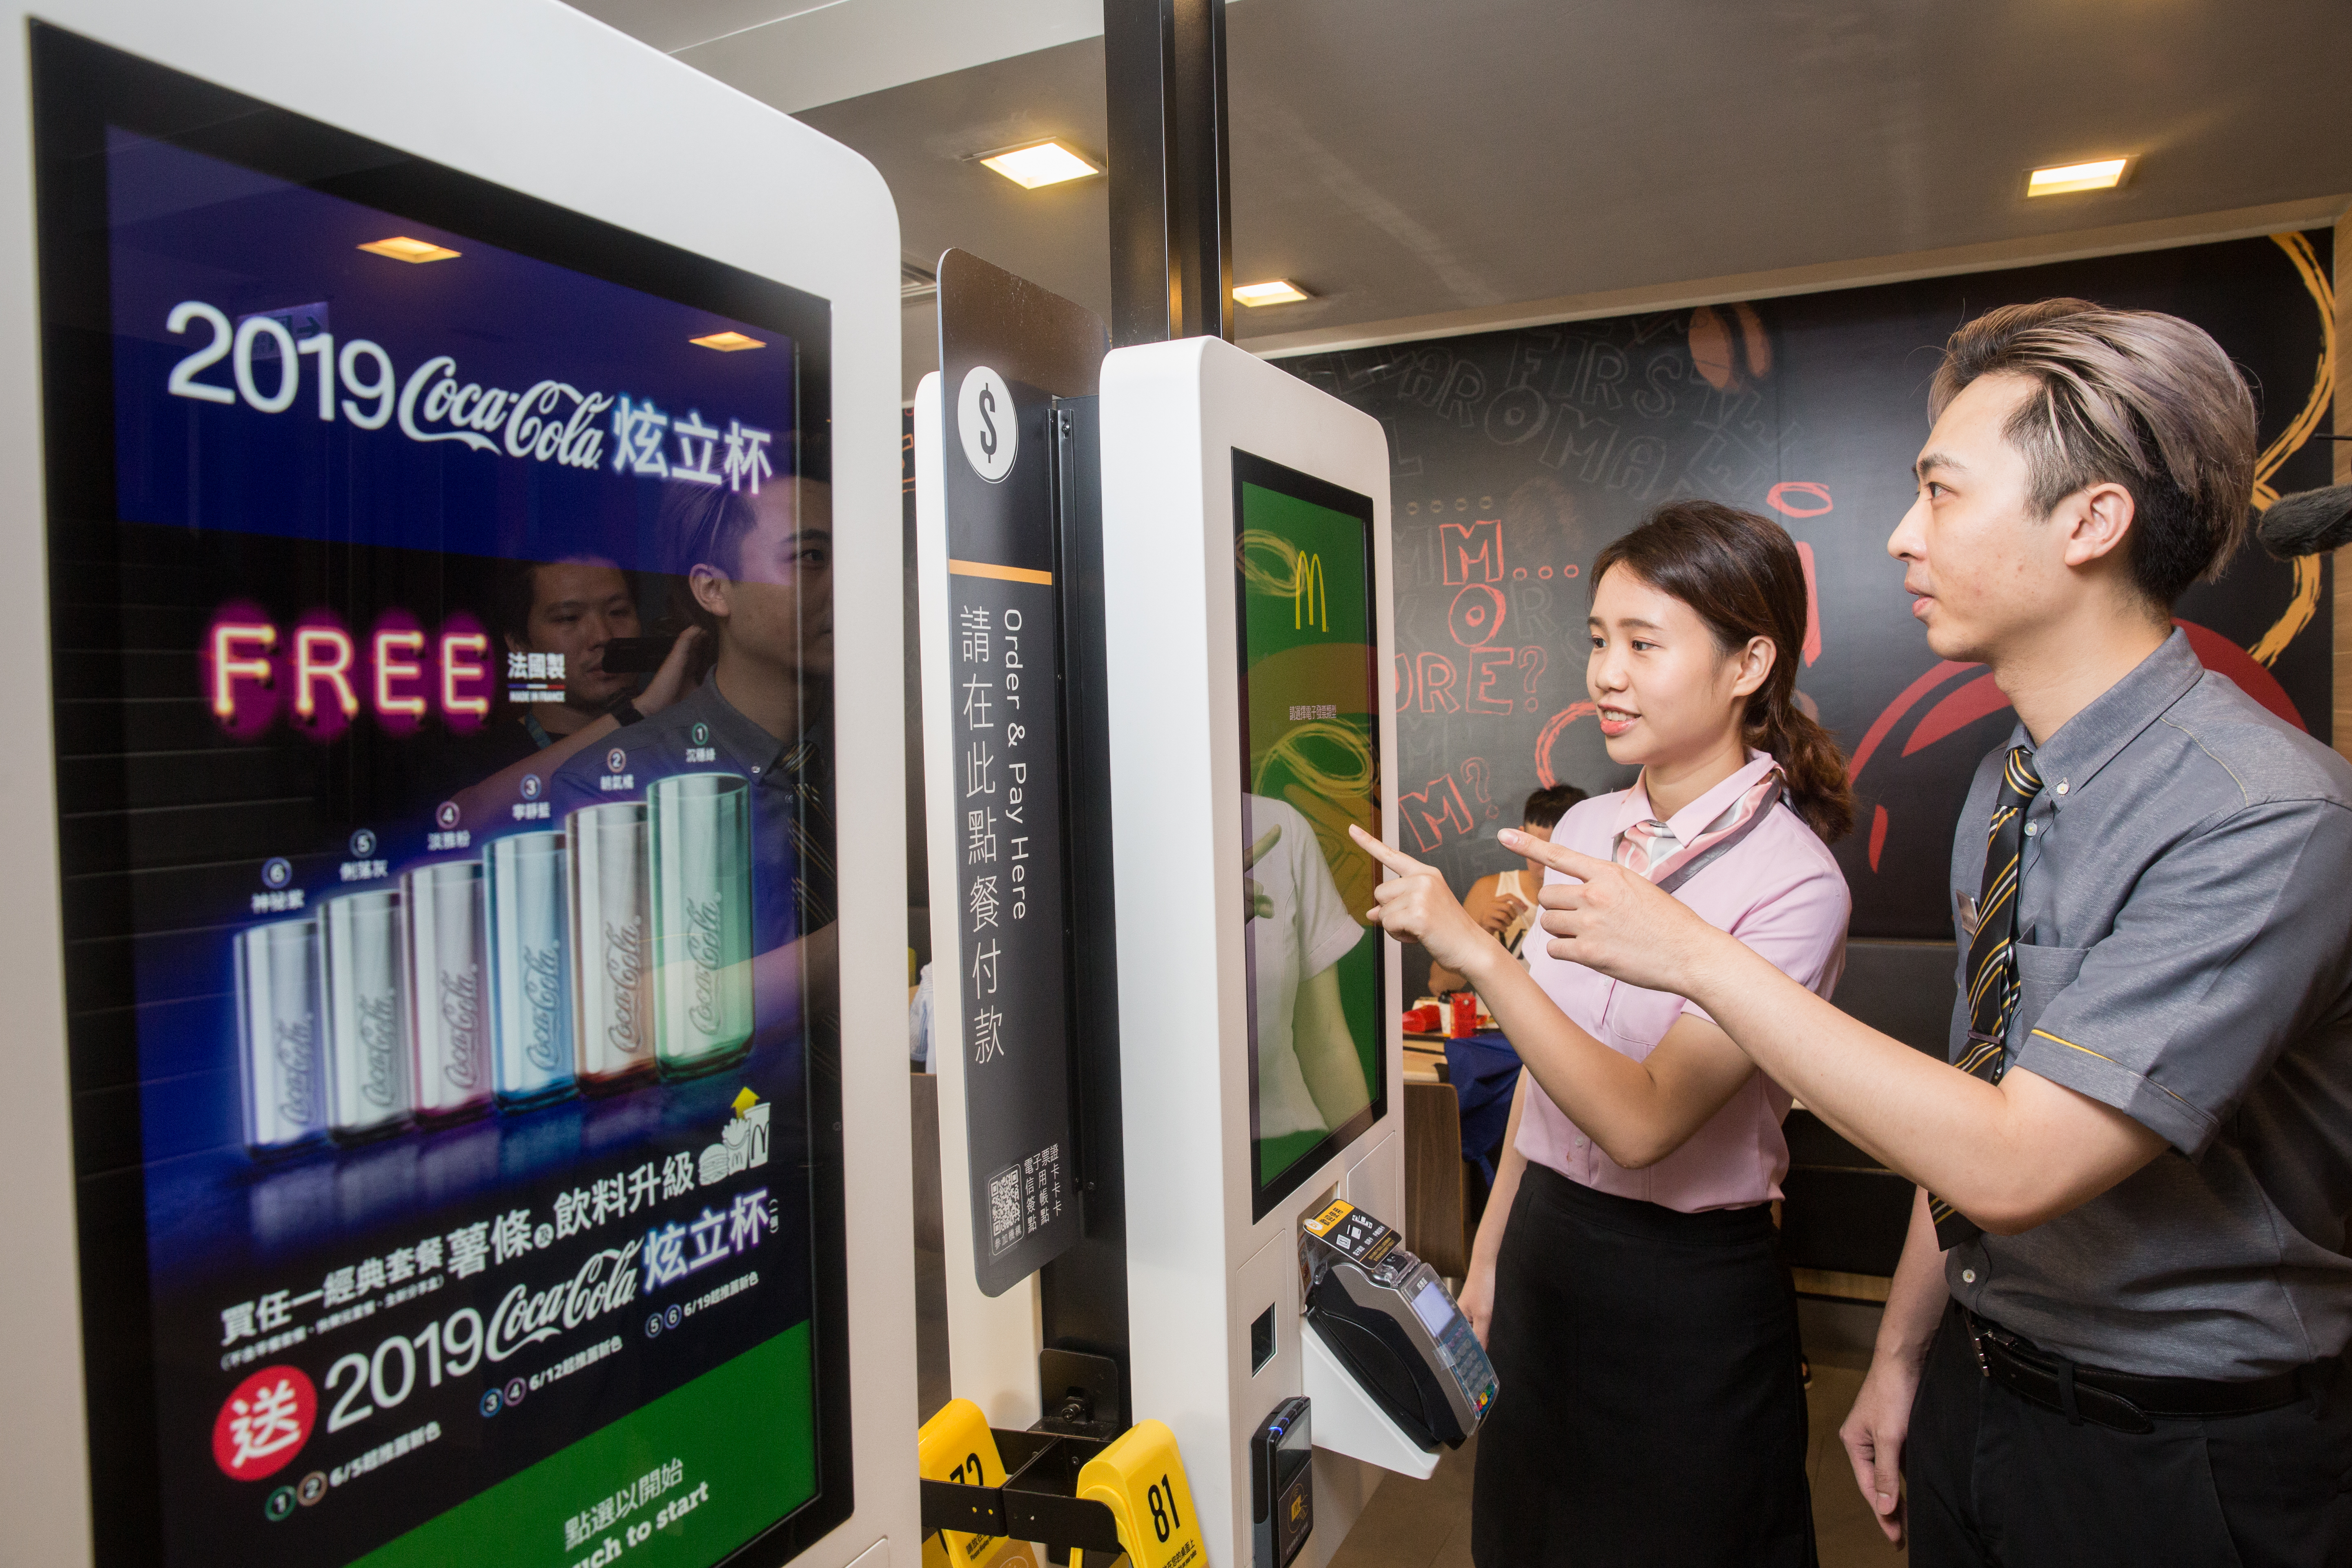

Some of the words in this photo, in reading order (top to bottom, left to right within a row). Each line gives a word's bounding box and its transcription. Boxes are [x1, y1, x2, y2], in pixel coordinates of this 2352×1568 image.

[166, 301, 394, 430] 2019
[398, 356, 614, 470] Coca-Cola
[614, 397, 773, 495] 炫立杯
[215, 623, 487, 715] FREE
[1004, 609, 1024, 705] Order
[1007, 723, 1025, 748] &
[1289, 705, 1336, 721] 請選擇電子發票類型
[1006, 762, 1027, 824] Pay
[960, 605, 1004, 1064] 請在此點餐付款
[1011, 837, 1029, 920] Here
[1024, 1143, 1059, 1175] 電子票證
[1025, 1163, 1060, 1196] 信用卡
[994, 1224, 1022, 1250] 參加機構
[1320, 1207, 1344, 1226] 歡迎使用
[1364, 1236, 1374, 1245] 信用卡
[220, 1236, 443, 1347] 買任一經典套餐
[326, 1308, 483, 1433] 2019
[486, 1236, 644, 1361] Coca-Cola
[644, 1189, 769, 1291] 炫立杯
[229, 1379, 301, 1468] 送
[564, 1457, 684, 1552] 點選以開始
[626, 1520, 652, 1548] to
[656, 1481, 709, 1530] start
[1148, 1473, 1180, 1543] 81
